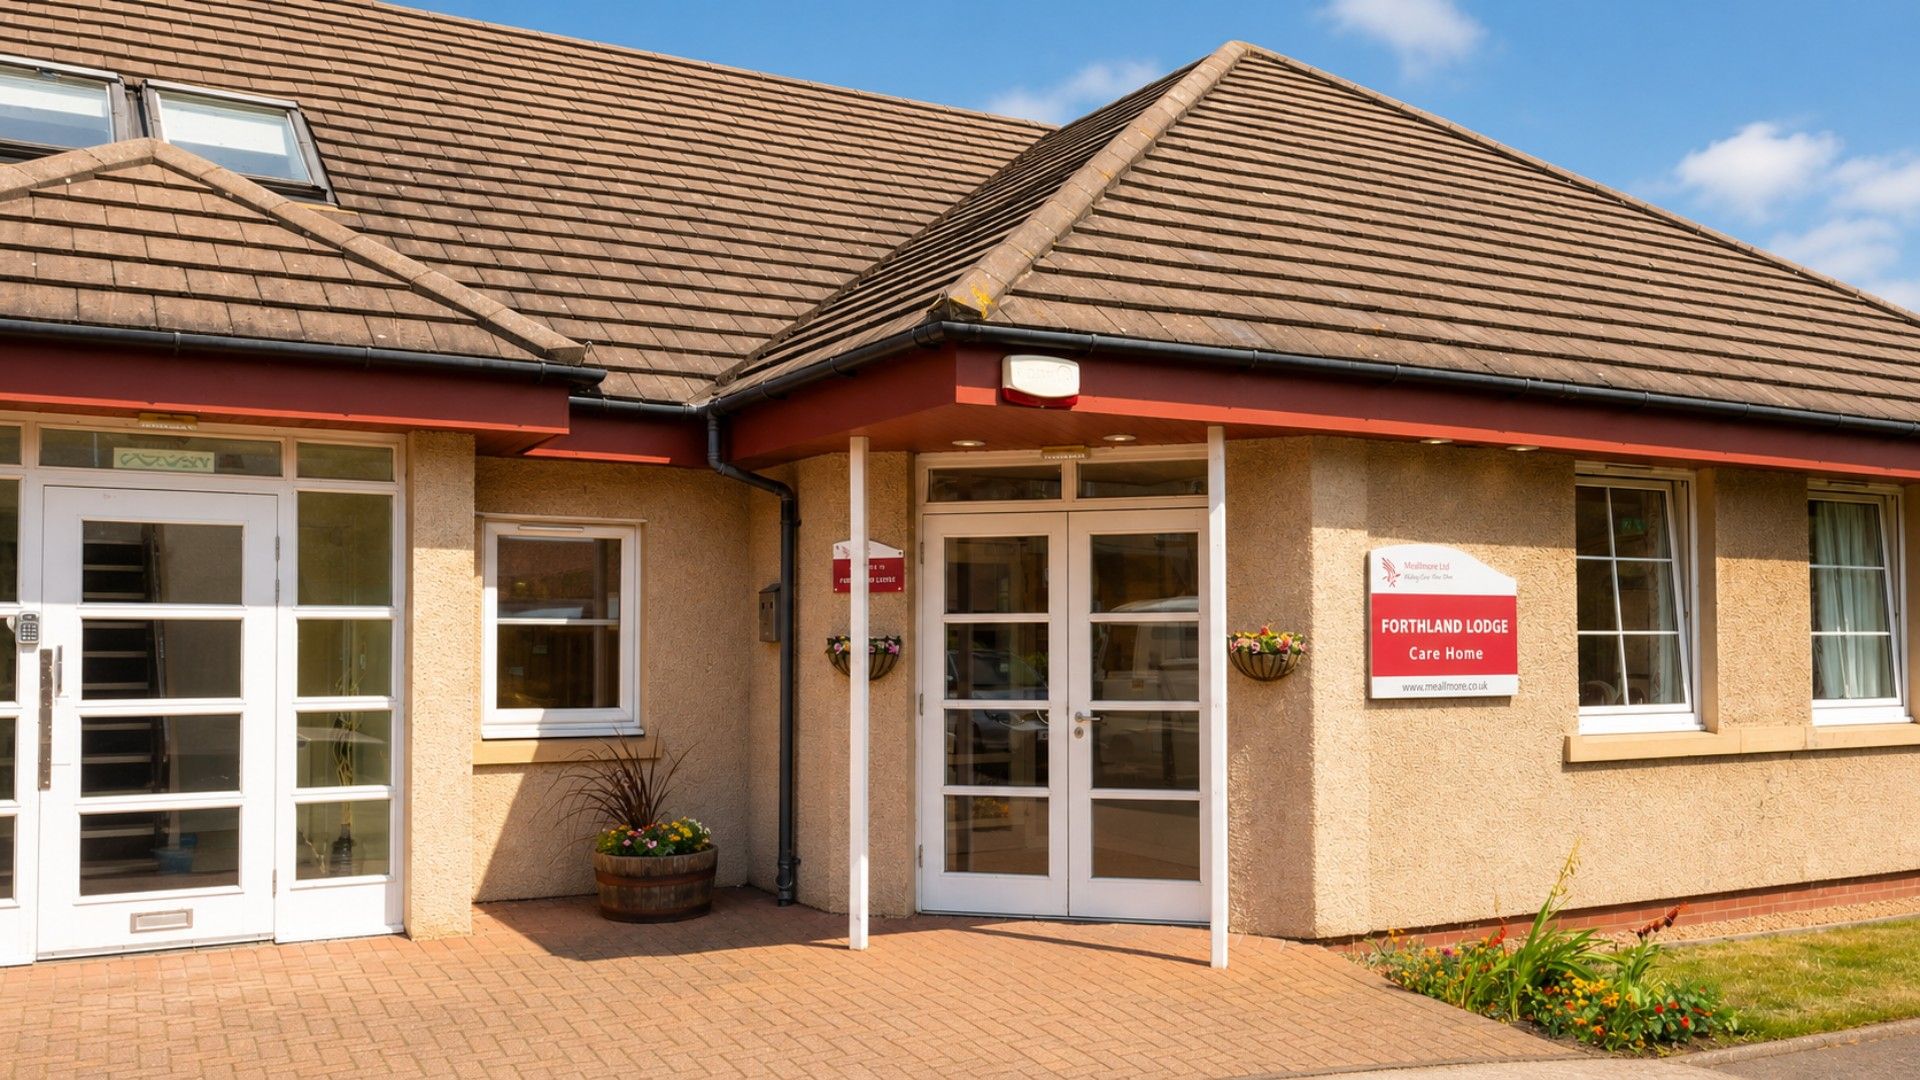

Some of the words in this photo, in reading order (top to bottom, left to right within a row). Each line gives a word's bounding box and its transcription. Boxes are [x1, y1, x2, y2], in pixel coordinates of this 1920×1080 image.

[1439, 562, 1450, 571] Ltd
[1381, 619, 1463, 633] FORTHLAND
[1466, 619, 1509, 633] LODGE
[1409, 646, 1440, 660] Care
[1445, 646, 1484, 660] Home
[1402, 681, 1488, 692] www.meallmore.co.uk
